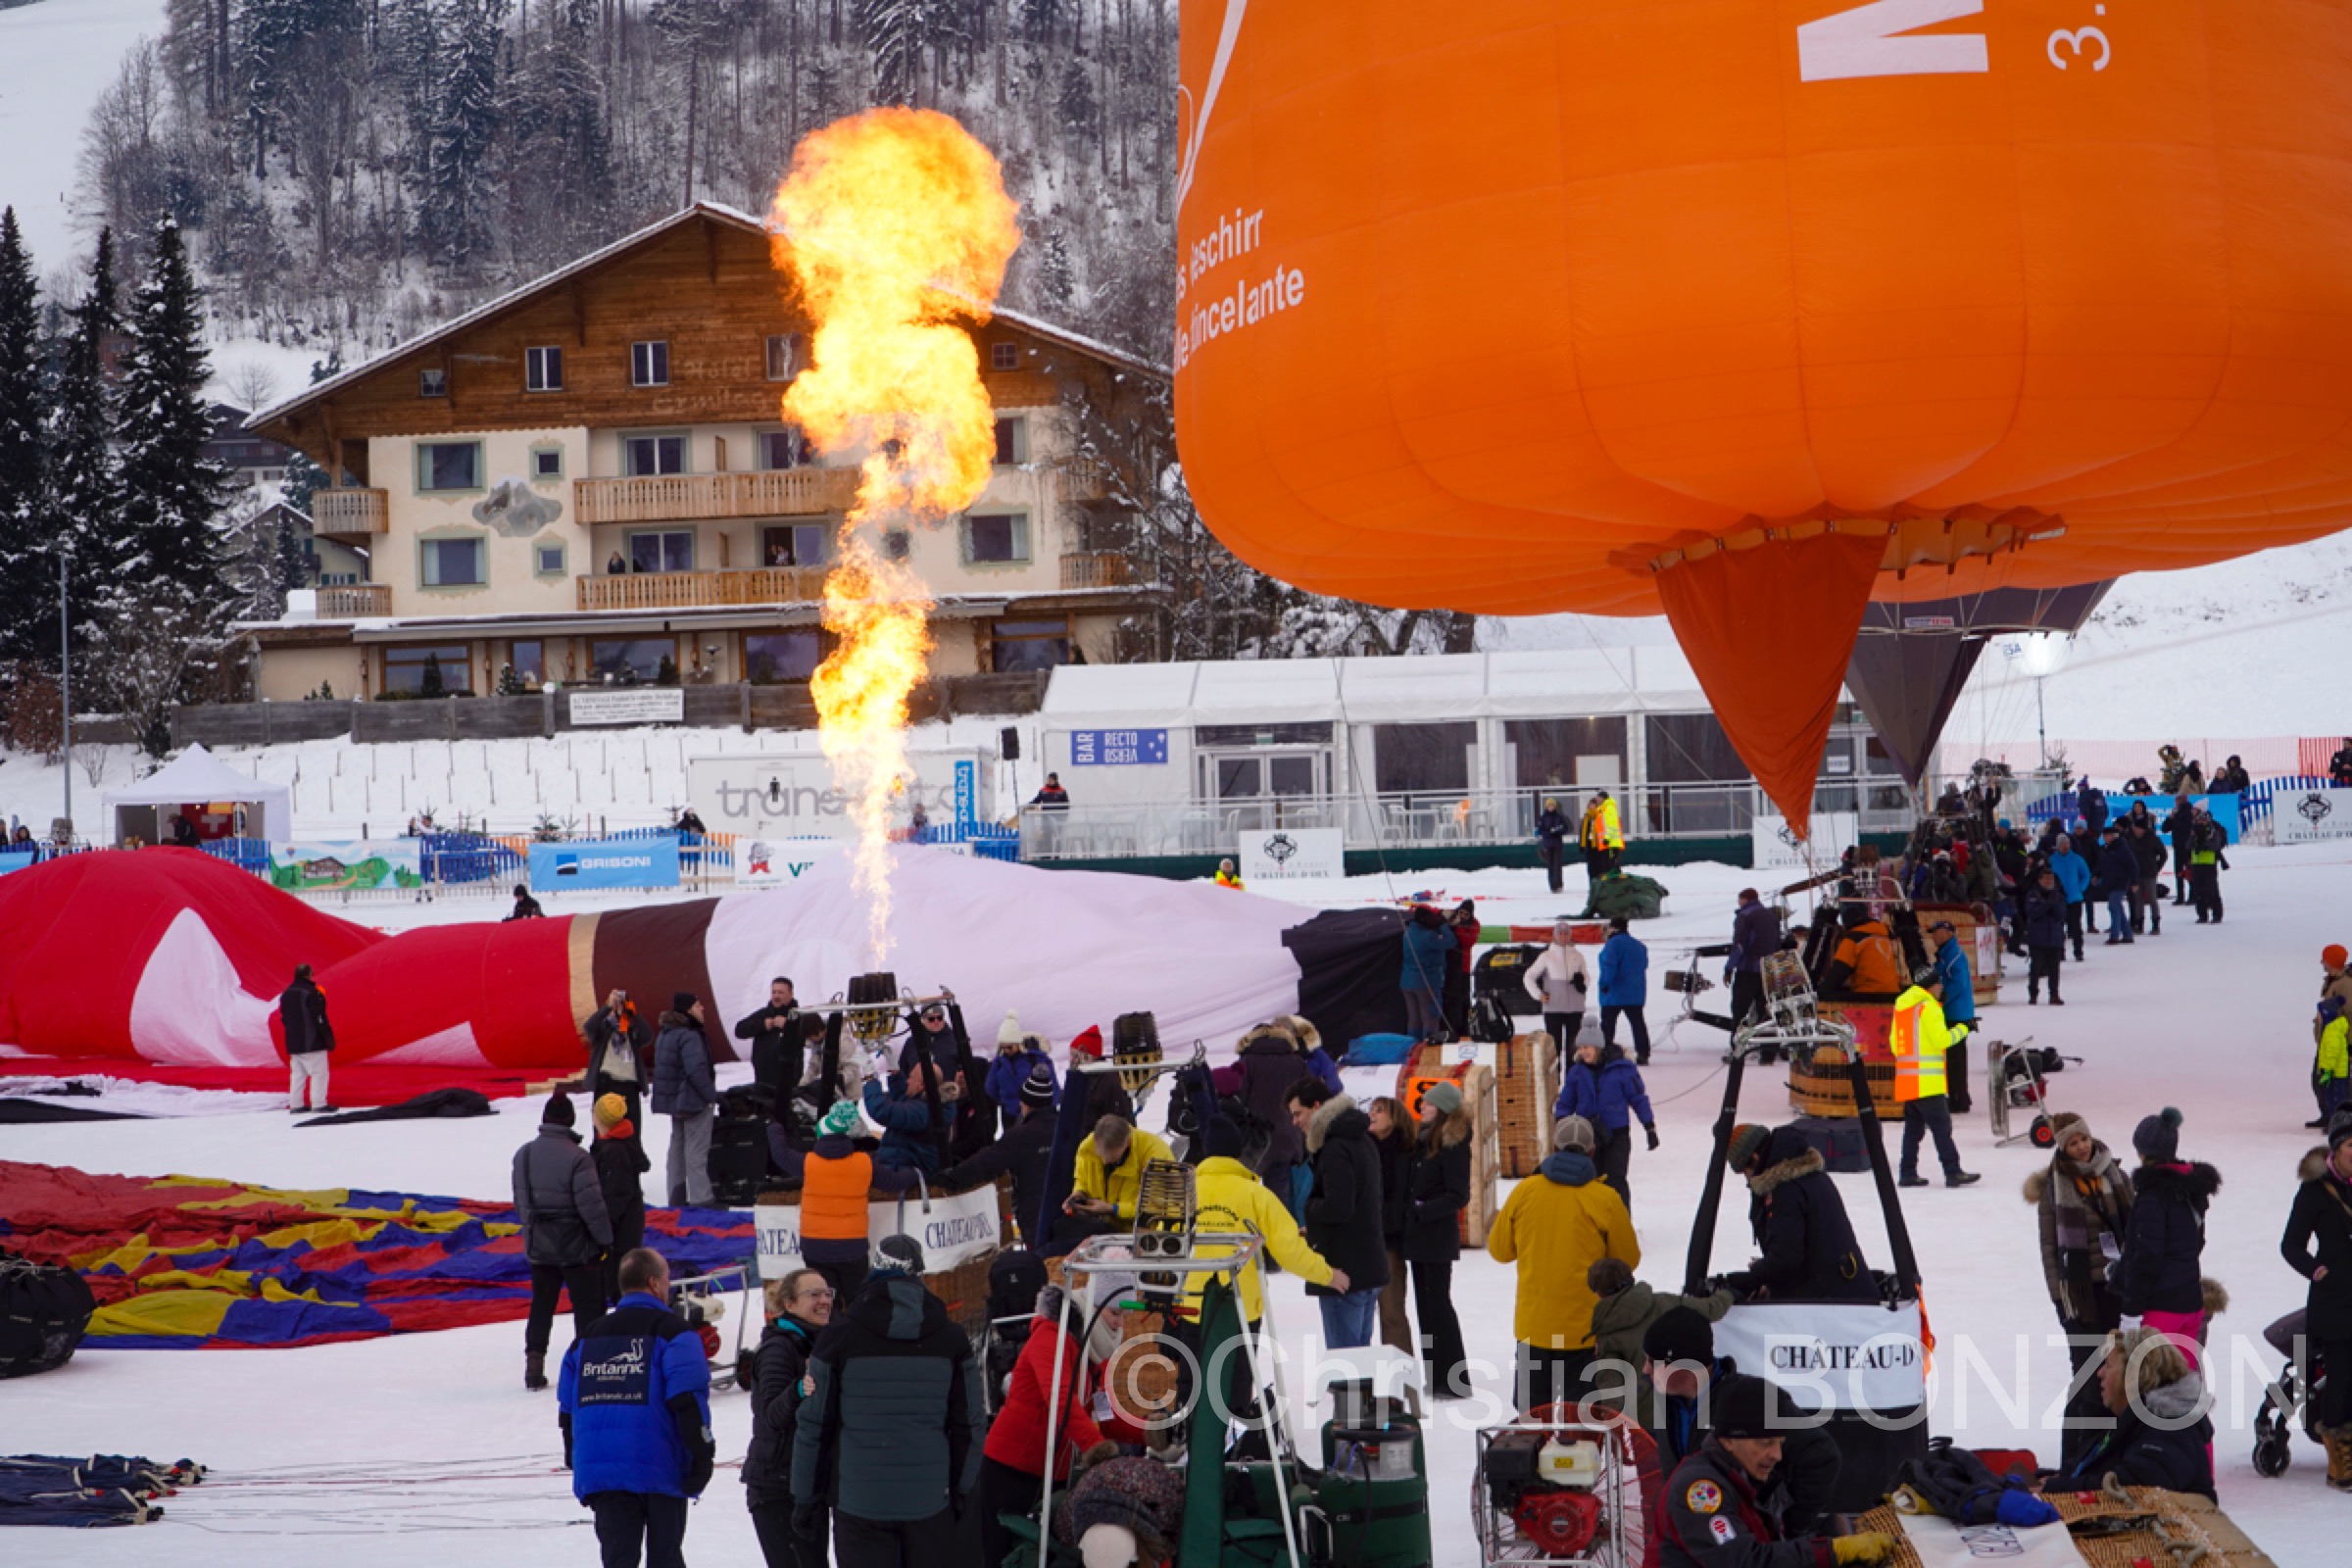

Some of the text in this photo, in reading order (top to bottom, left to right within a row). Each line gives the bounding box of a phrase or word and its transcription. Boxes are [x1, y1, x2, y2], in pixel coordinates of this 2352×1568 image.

[652, 386, 781, 415] Ermitag
[1076, 732, 1095, 762] BAR
[1104, 732, 1138, 747] RECTO
[581, 856, 652, 869] GRISONI
[582, 1361, 646, 1377] Britannic
